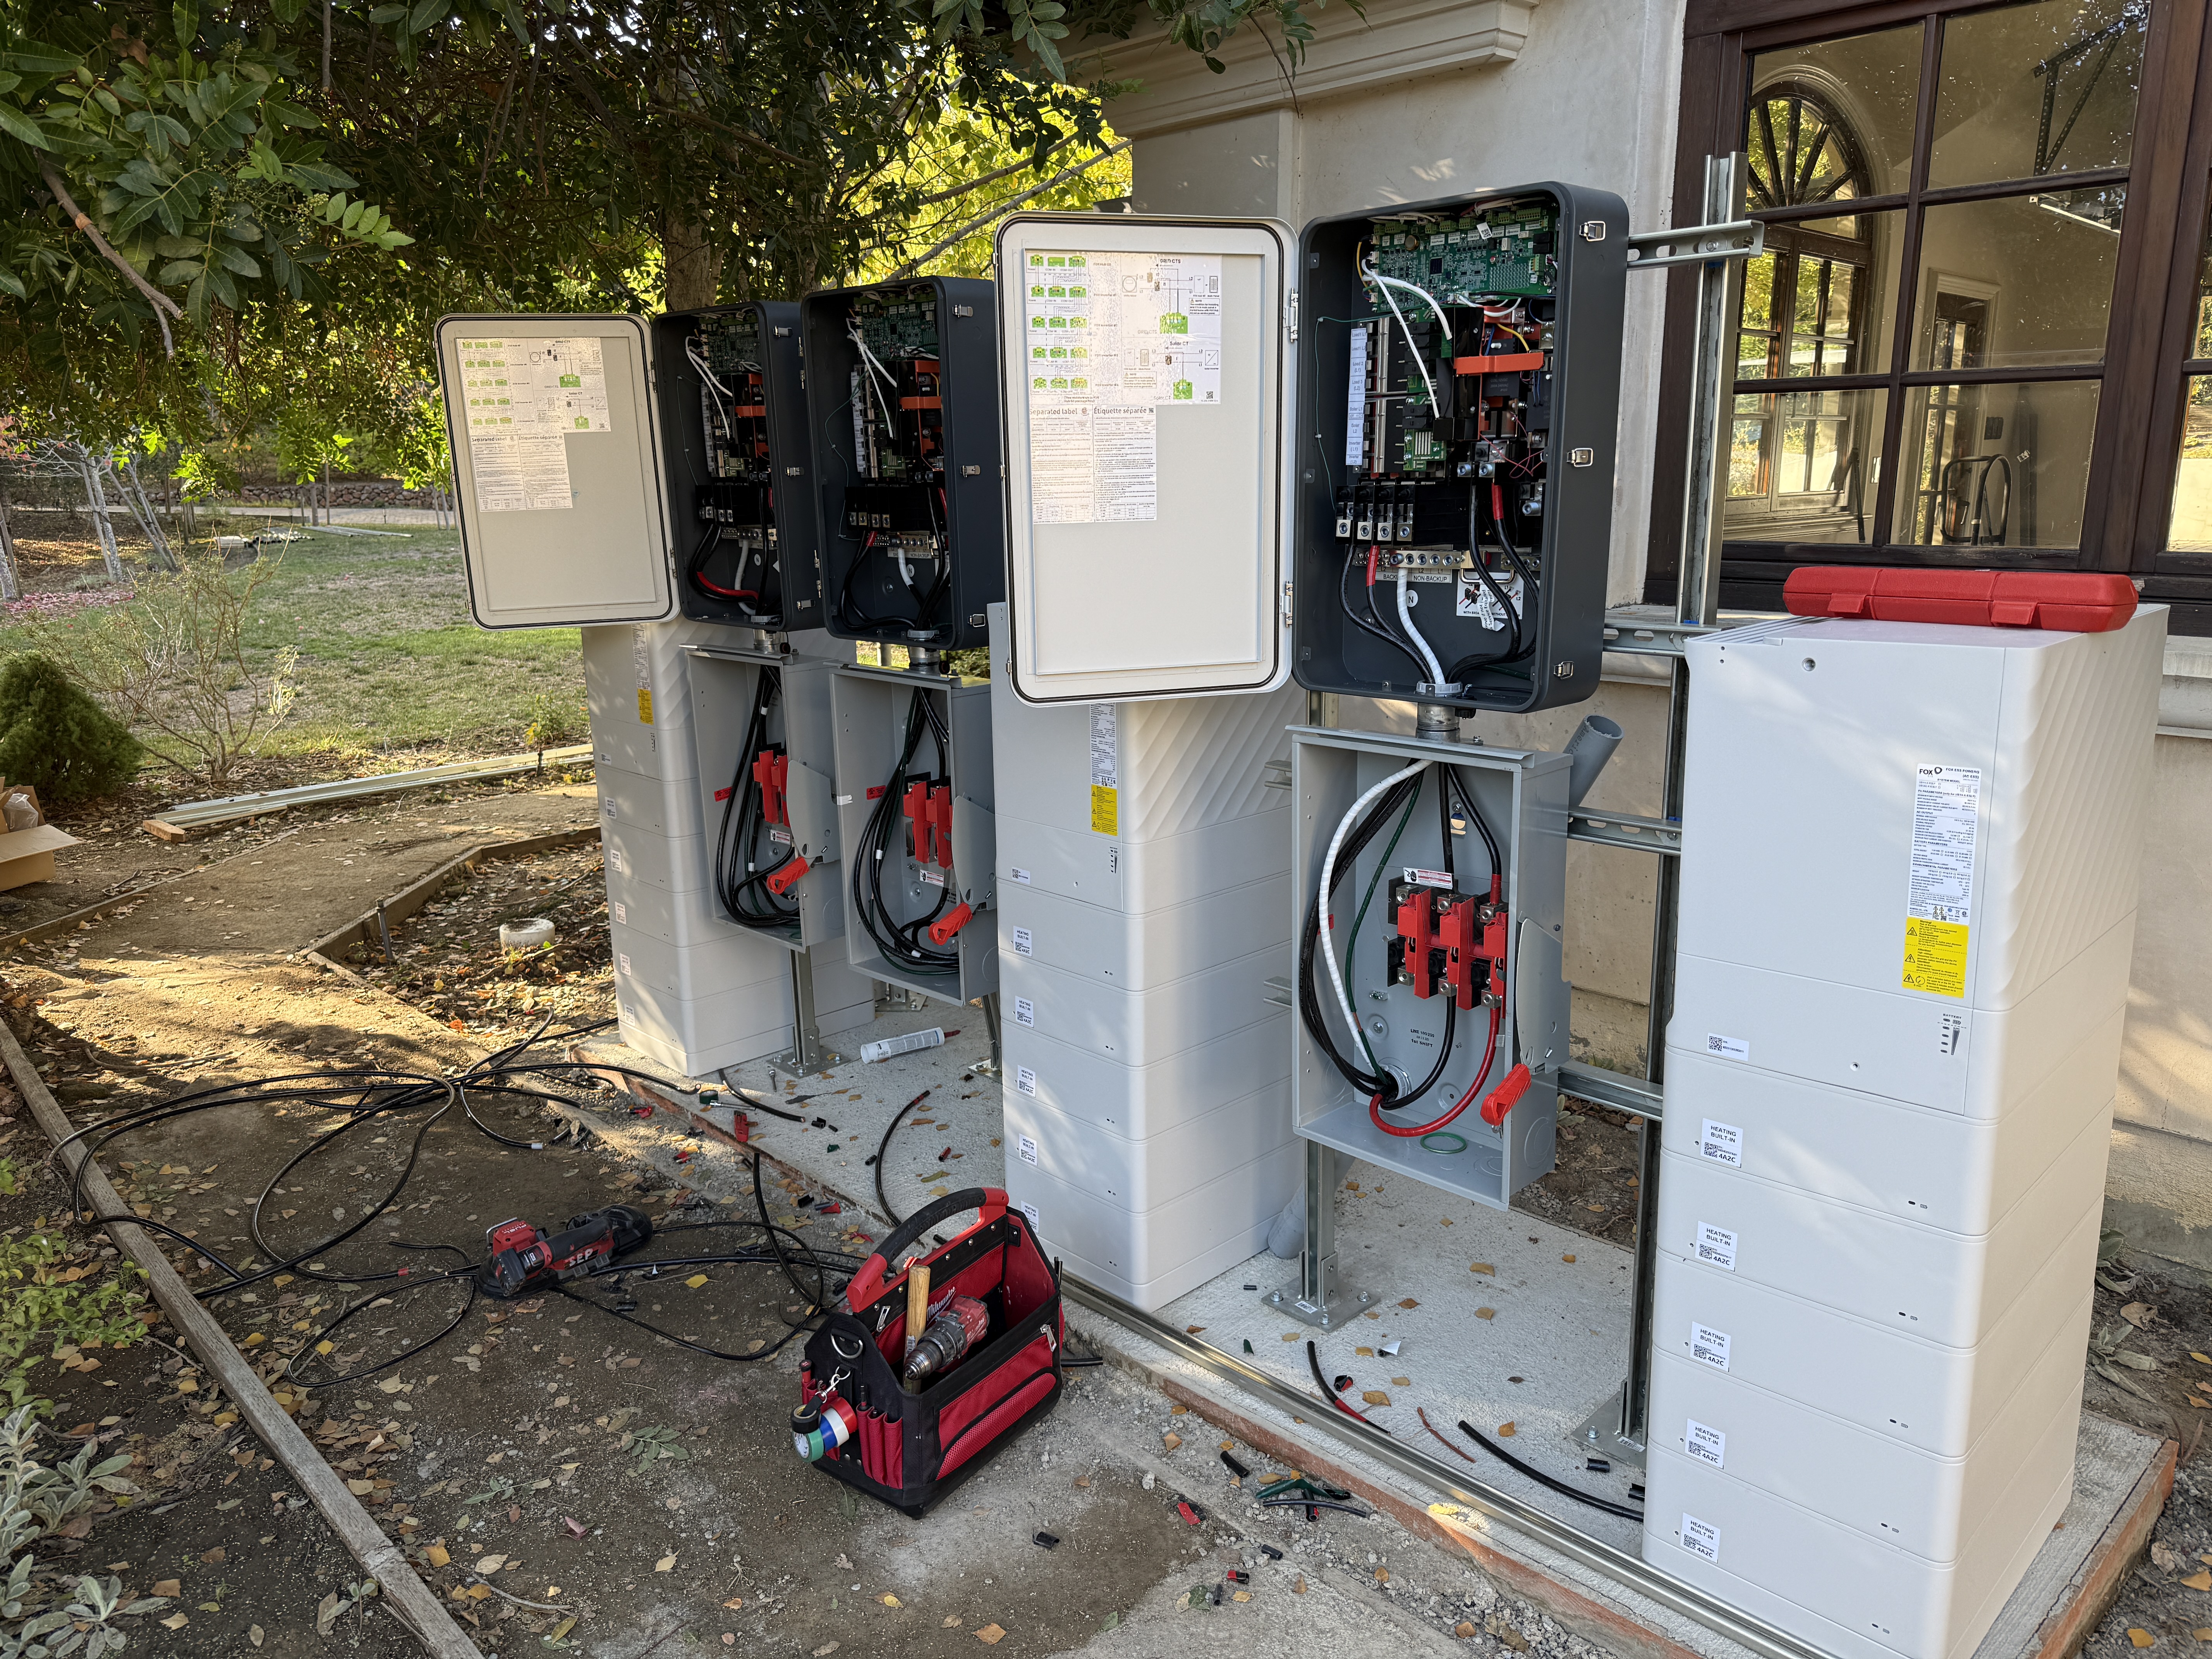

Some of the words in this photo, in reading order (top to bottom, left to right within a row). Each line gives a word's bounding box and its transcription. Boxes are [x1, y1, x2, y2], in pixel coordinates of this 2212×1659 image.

[1094, 406, 1121, 416] Étiquette
[1123, 407, 1146, 416] séparée
[1711, 1126, 1736, 1136] HEATING
[1711, 1132, 1735, 1143] BUILT-IN
[1719, 1154, 1735, 1163] 4A2C
[504, 1224, 527, 1233] FUEL
[1707, 1228, 1731, 1240] HEATING
[1707, 1235, 1730, 1246] BUILT-IN
[1714, 1256, 1730, 1265] 4A2C
[927, 1286, 956, 1321] Milwaukee
[1700, 1329, 1724, 1341] HEATING
[1700, 1335, 1723, 1347] BUILT-IN
[1708, 1357, 1724, 1366] 4A2C
[1695, 1427, 1719, 1439] HEATING
[1696, 1432, 1718, 1445] BUILT-IN
[1702, 1453, 1718, 1463] 4A2C
[1691, 1520, 1714, 1534] HEATING
[1691, 1527, 1713, 1540] BUILT-IN
[1697, 1547, 1713, 1558] 4A2C
